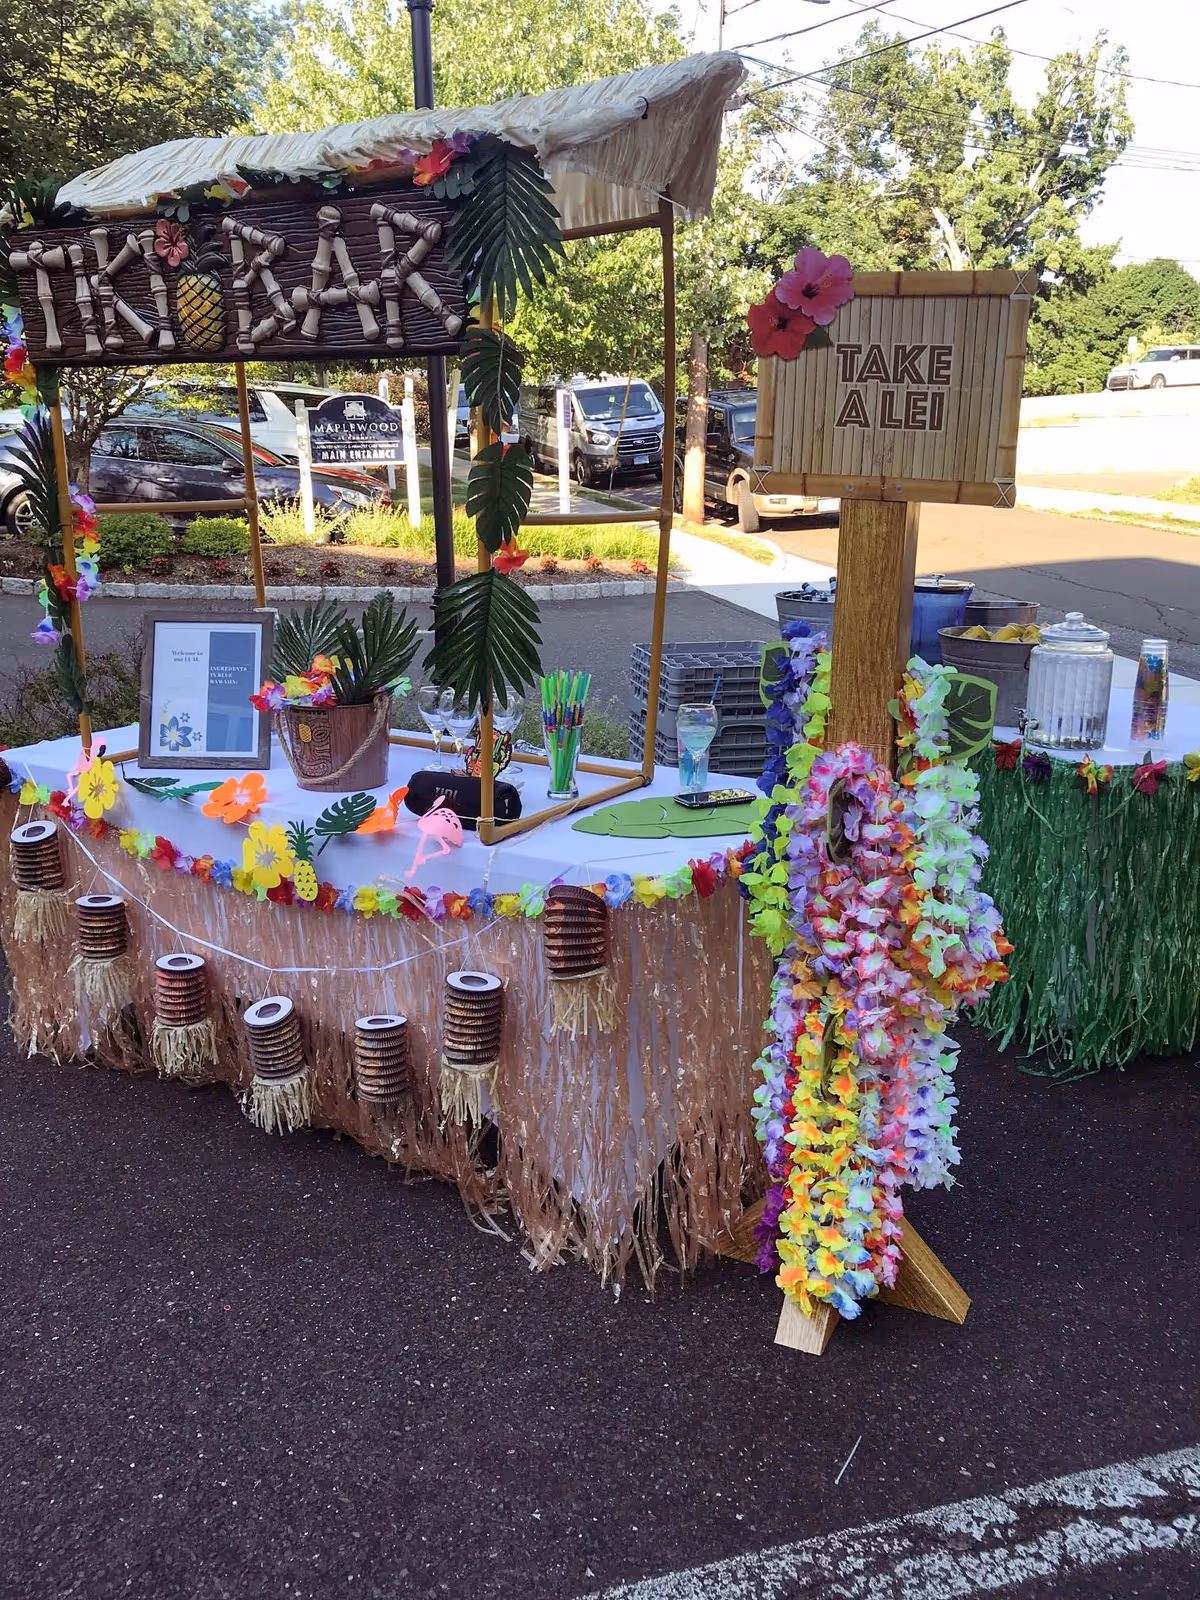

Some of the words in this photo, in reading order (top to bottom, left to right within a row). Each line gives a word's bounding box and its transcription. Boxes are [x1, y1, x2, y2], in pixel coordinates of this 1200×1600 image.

[8, 226, 176, 357] TIKI
[221, 202, 463, 354] BAR
[836, 343, 953, 386] TAKE
[314, 422, 399, 433] MAPLEWOOD
[835, 389, 871, 429] A
[879, 390, 945, 431] LEI
[321, 449, 346, 460] MAIN
[349, 448, 396, 460] ENTRANCE
